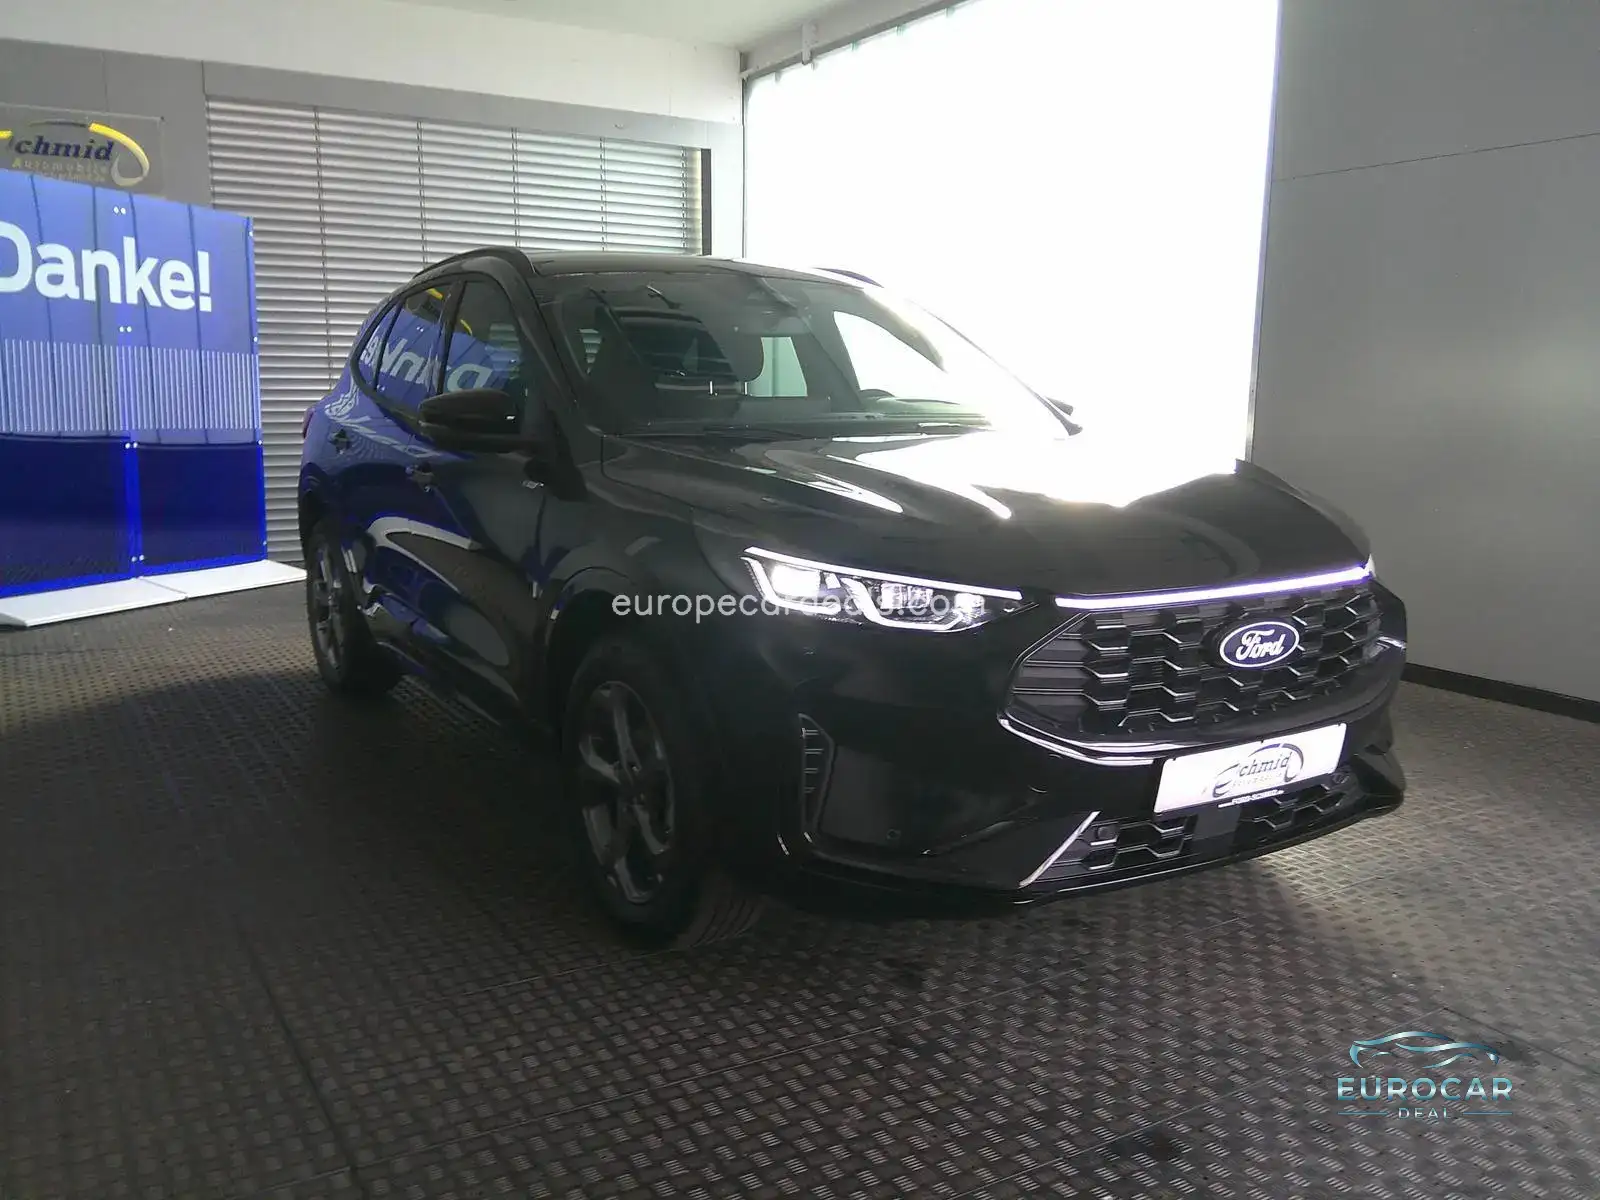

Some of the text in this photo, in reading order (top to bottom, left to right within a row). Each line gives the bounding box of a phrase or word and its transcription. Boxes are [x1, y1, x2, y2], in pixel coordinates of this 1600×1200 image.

[2, 133, 114, 161] chmid
[0, 220, 212, 313] Danke!
[1235, 629, 1286, 661] Ford
